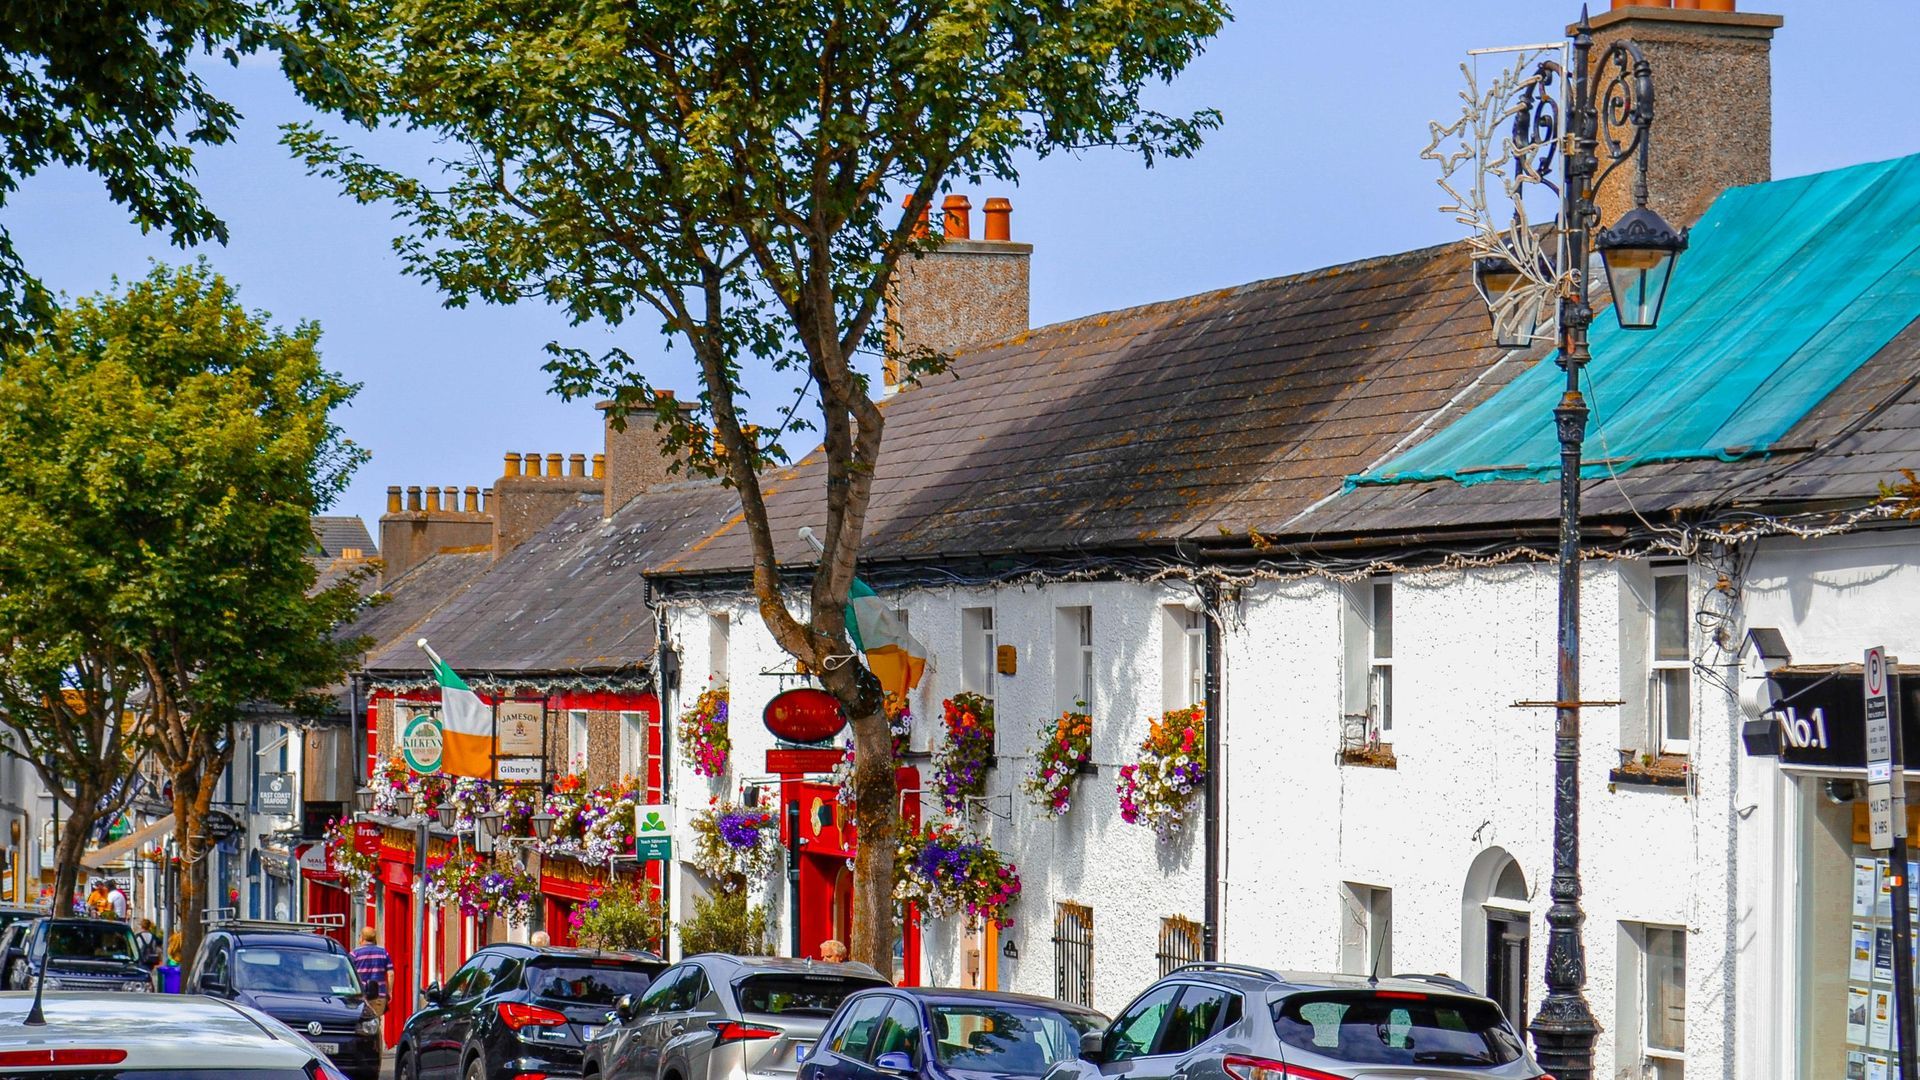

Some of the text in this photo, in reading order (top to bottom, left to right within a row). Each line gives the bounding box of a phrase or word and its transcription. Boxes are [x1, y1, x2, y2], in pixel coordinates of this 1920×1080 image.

[501, 712, 538, 723] JAMESON
[1776, 706, 1828, 749] No.1
[500, 766, 538, 775] Gibney's
